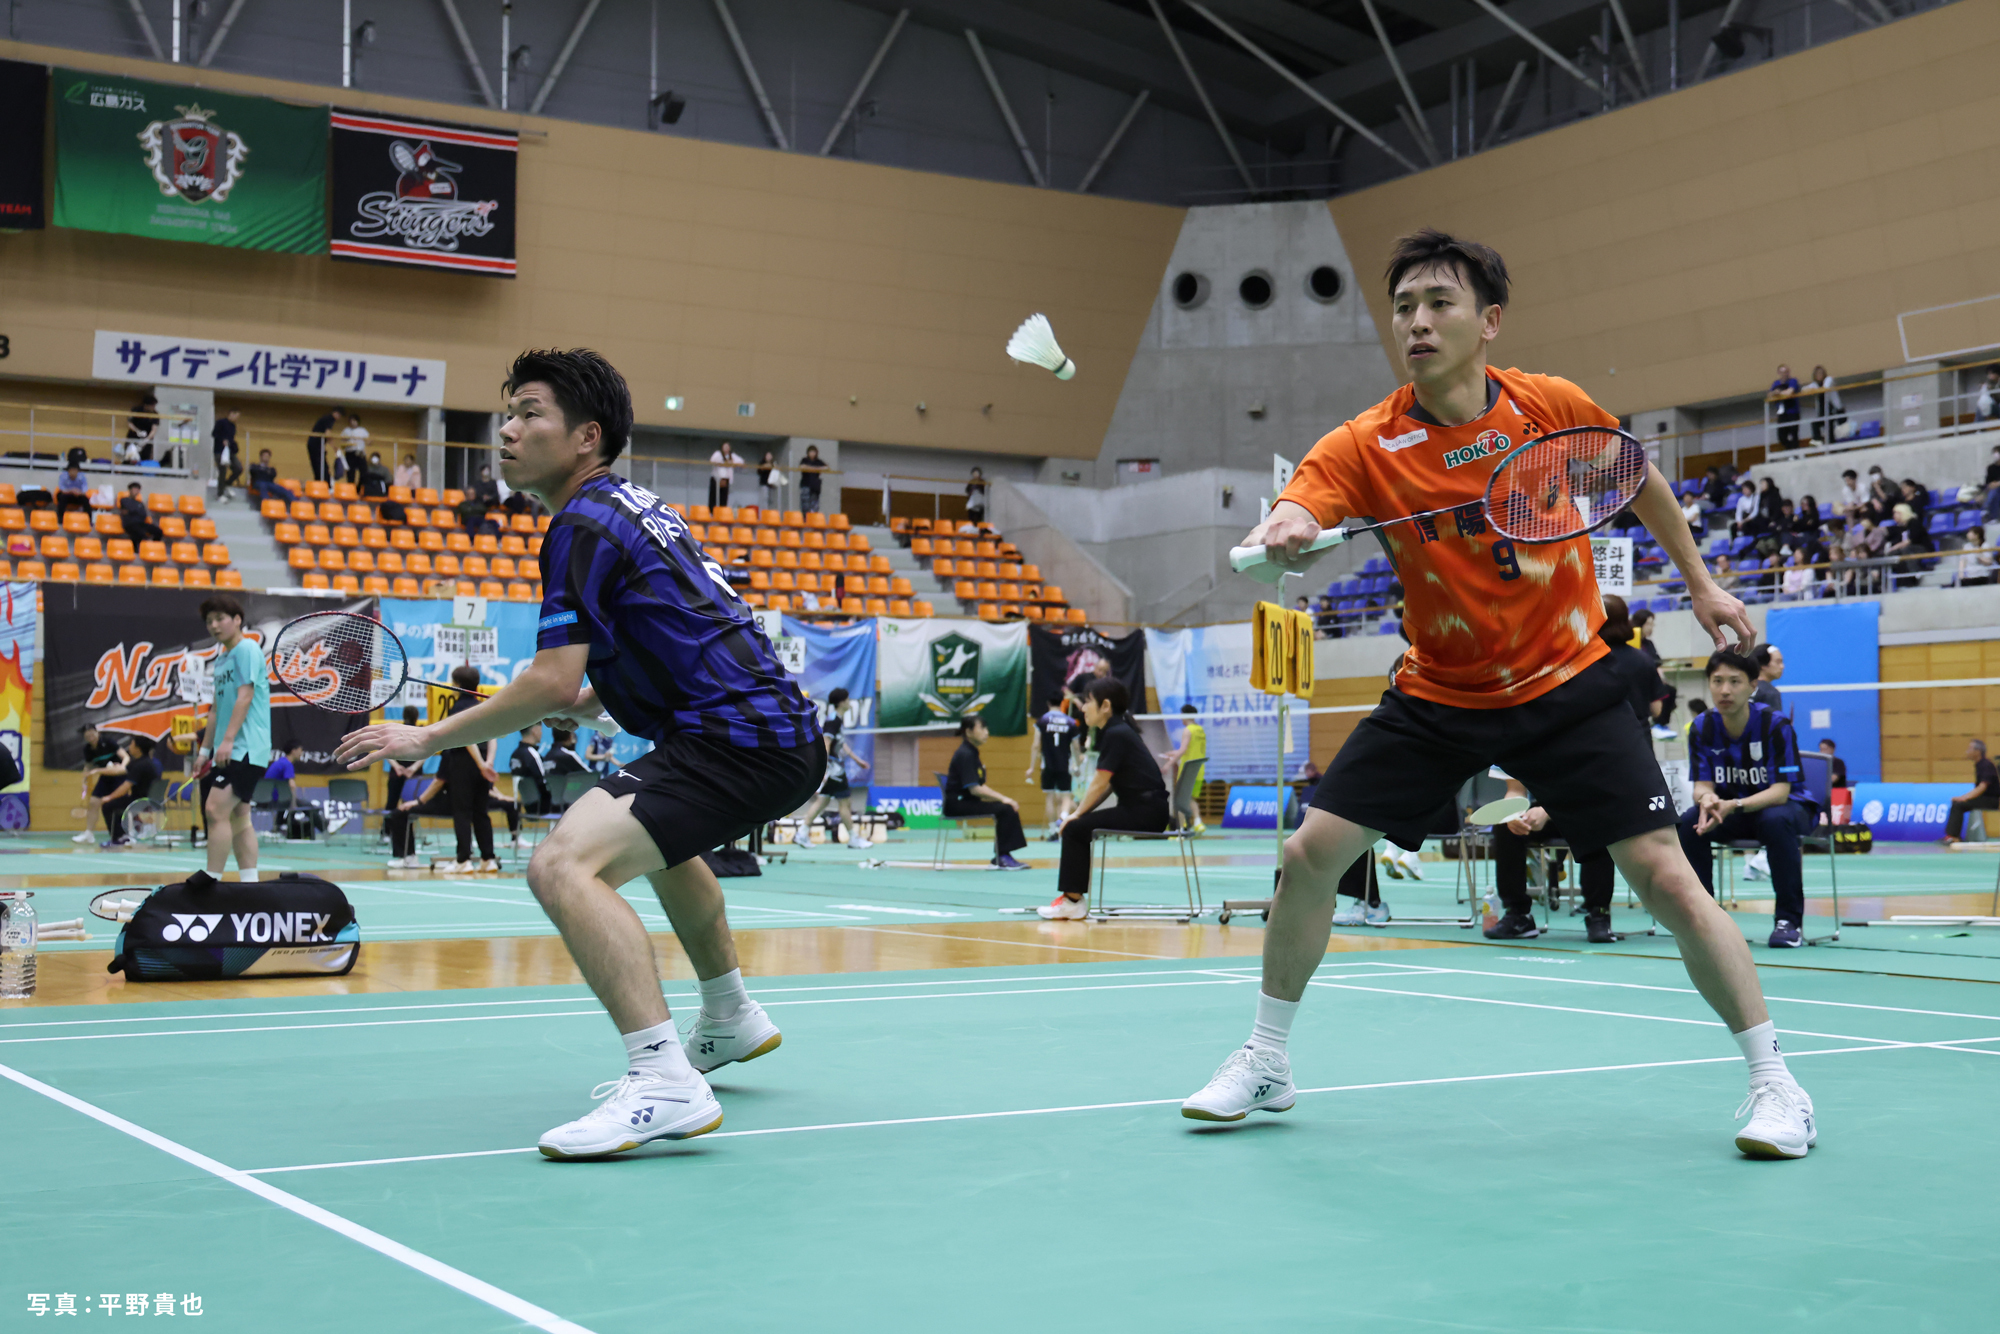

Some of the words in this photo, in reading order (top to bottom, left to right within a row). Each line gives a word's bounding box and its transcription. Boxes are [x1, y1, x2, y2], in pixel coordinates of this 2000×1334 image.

[90, 92, 147, 113] 広島ガス
[351, 191, 495, 247] Stingers
[116, 341, 427, 397] サイデン化学アリーナ
[1443, 429, 1512, 470] HOKTO
[1491, 538, 1522, 582] 9
[467, 602, 475, 620] 7
[756, 615, 766, 631] 8
[1271, 620, 1283, 686] 20
[1300, 628, 1311, 691] 20
[1212, 694, 1279, 728] BANK
[1053, 732, 1059, 747] 1
[902, 798, 942, 816] YONE
[230, 912, 333, 943] YONEX
